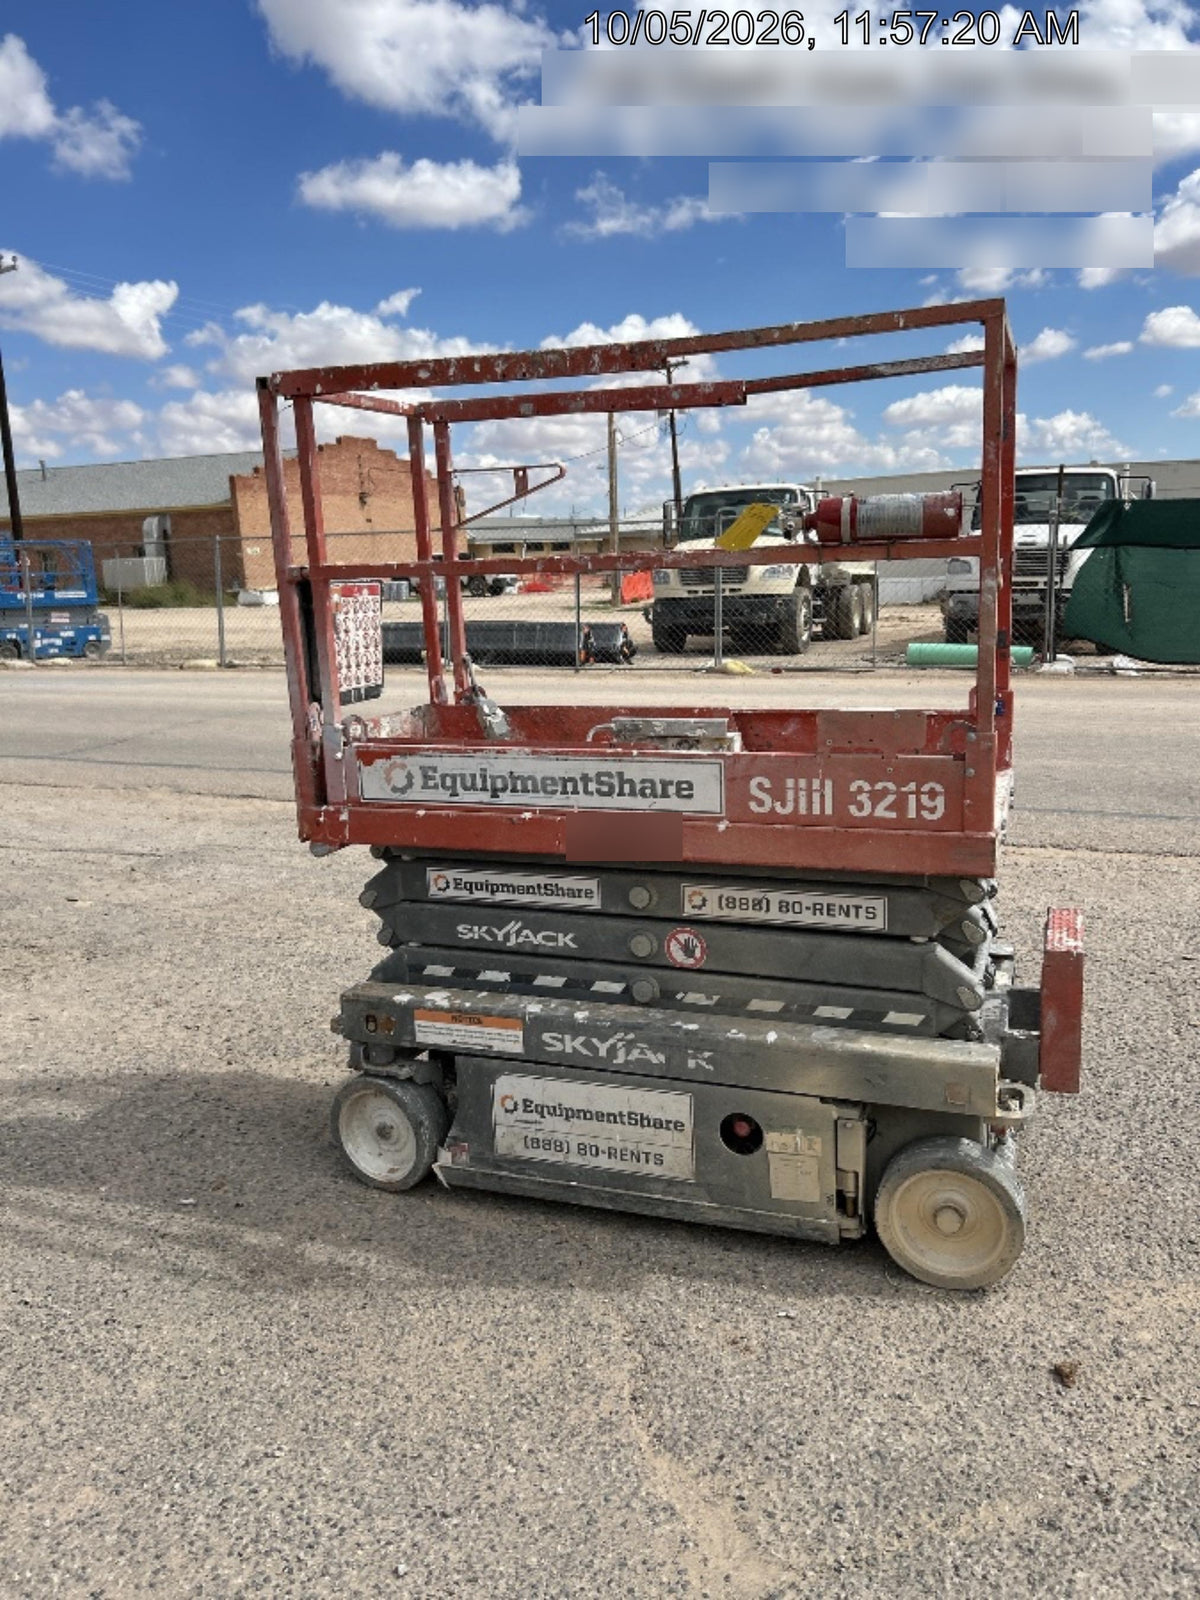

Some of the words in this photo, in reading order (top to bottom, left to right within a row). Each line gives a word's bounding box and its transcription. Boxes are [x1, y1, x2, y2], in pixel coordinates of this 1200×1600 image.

[419, 765, 694, 799] EquipmentShare
[848, 779, 945, 821] 3219
[453, 877, 594, 899] EquipmentShare
[718, 894, 771, 913] (888)
[778, 900, 877, 920] 80-RENTS
[456, 920, 578, 948] SKYJACK
[541, 1032, 714, 1071] SKYJAK
[522, 1098, 686, 1132] EquipmentShare
[523, 1135, 570, 1155] (888)
[577, 1142, 664, 1166] 80-RENTS
